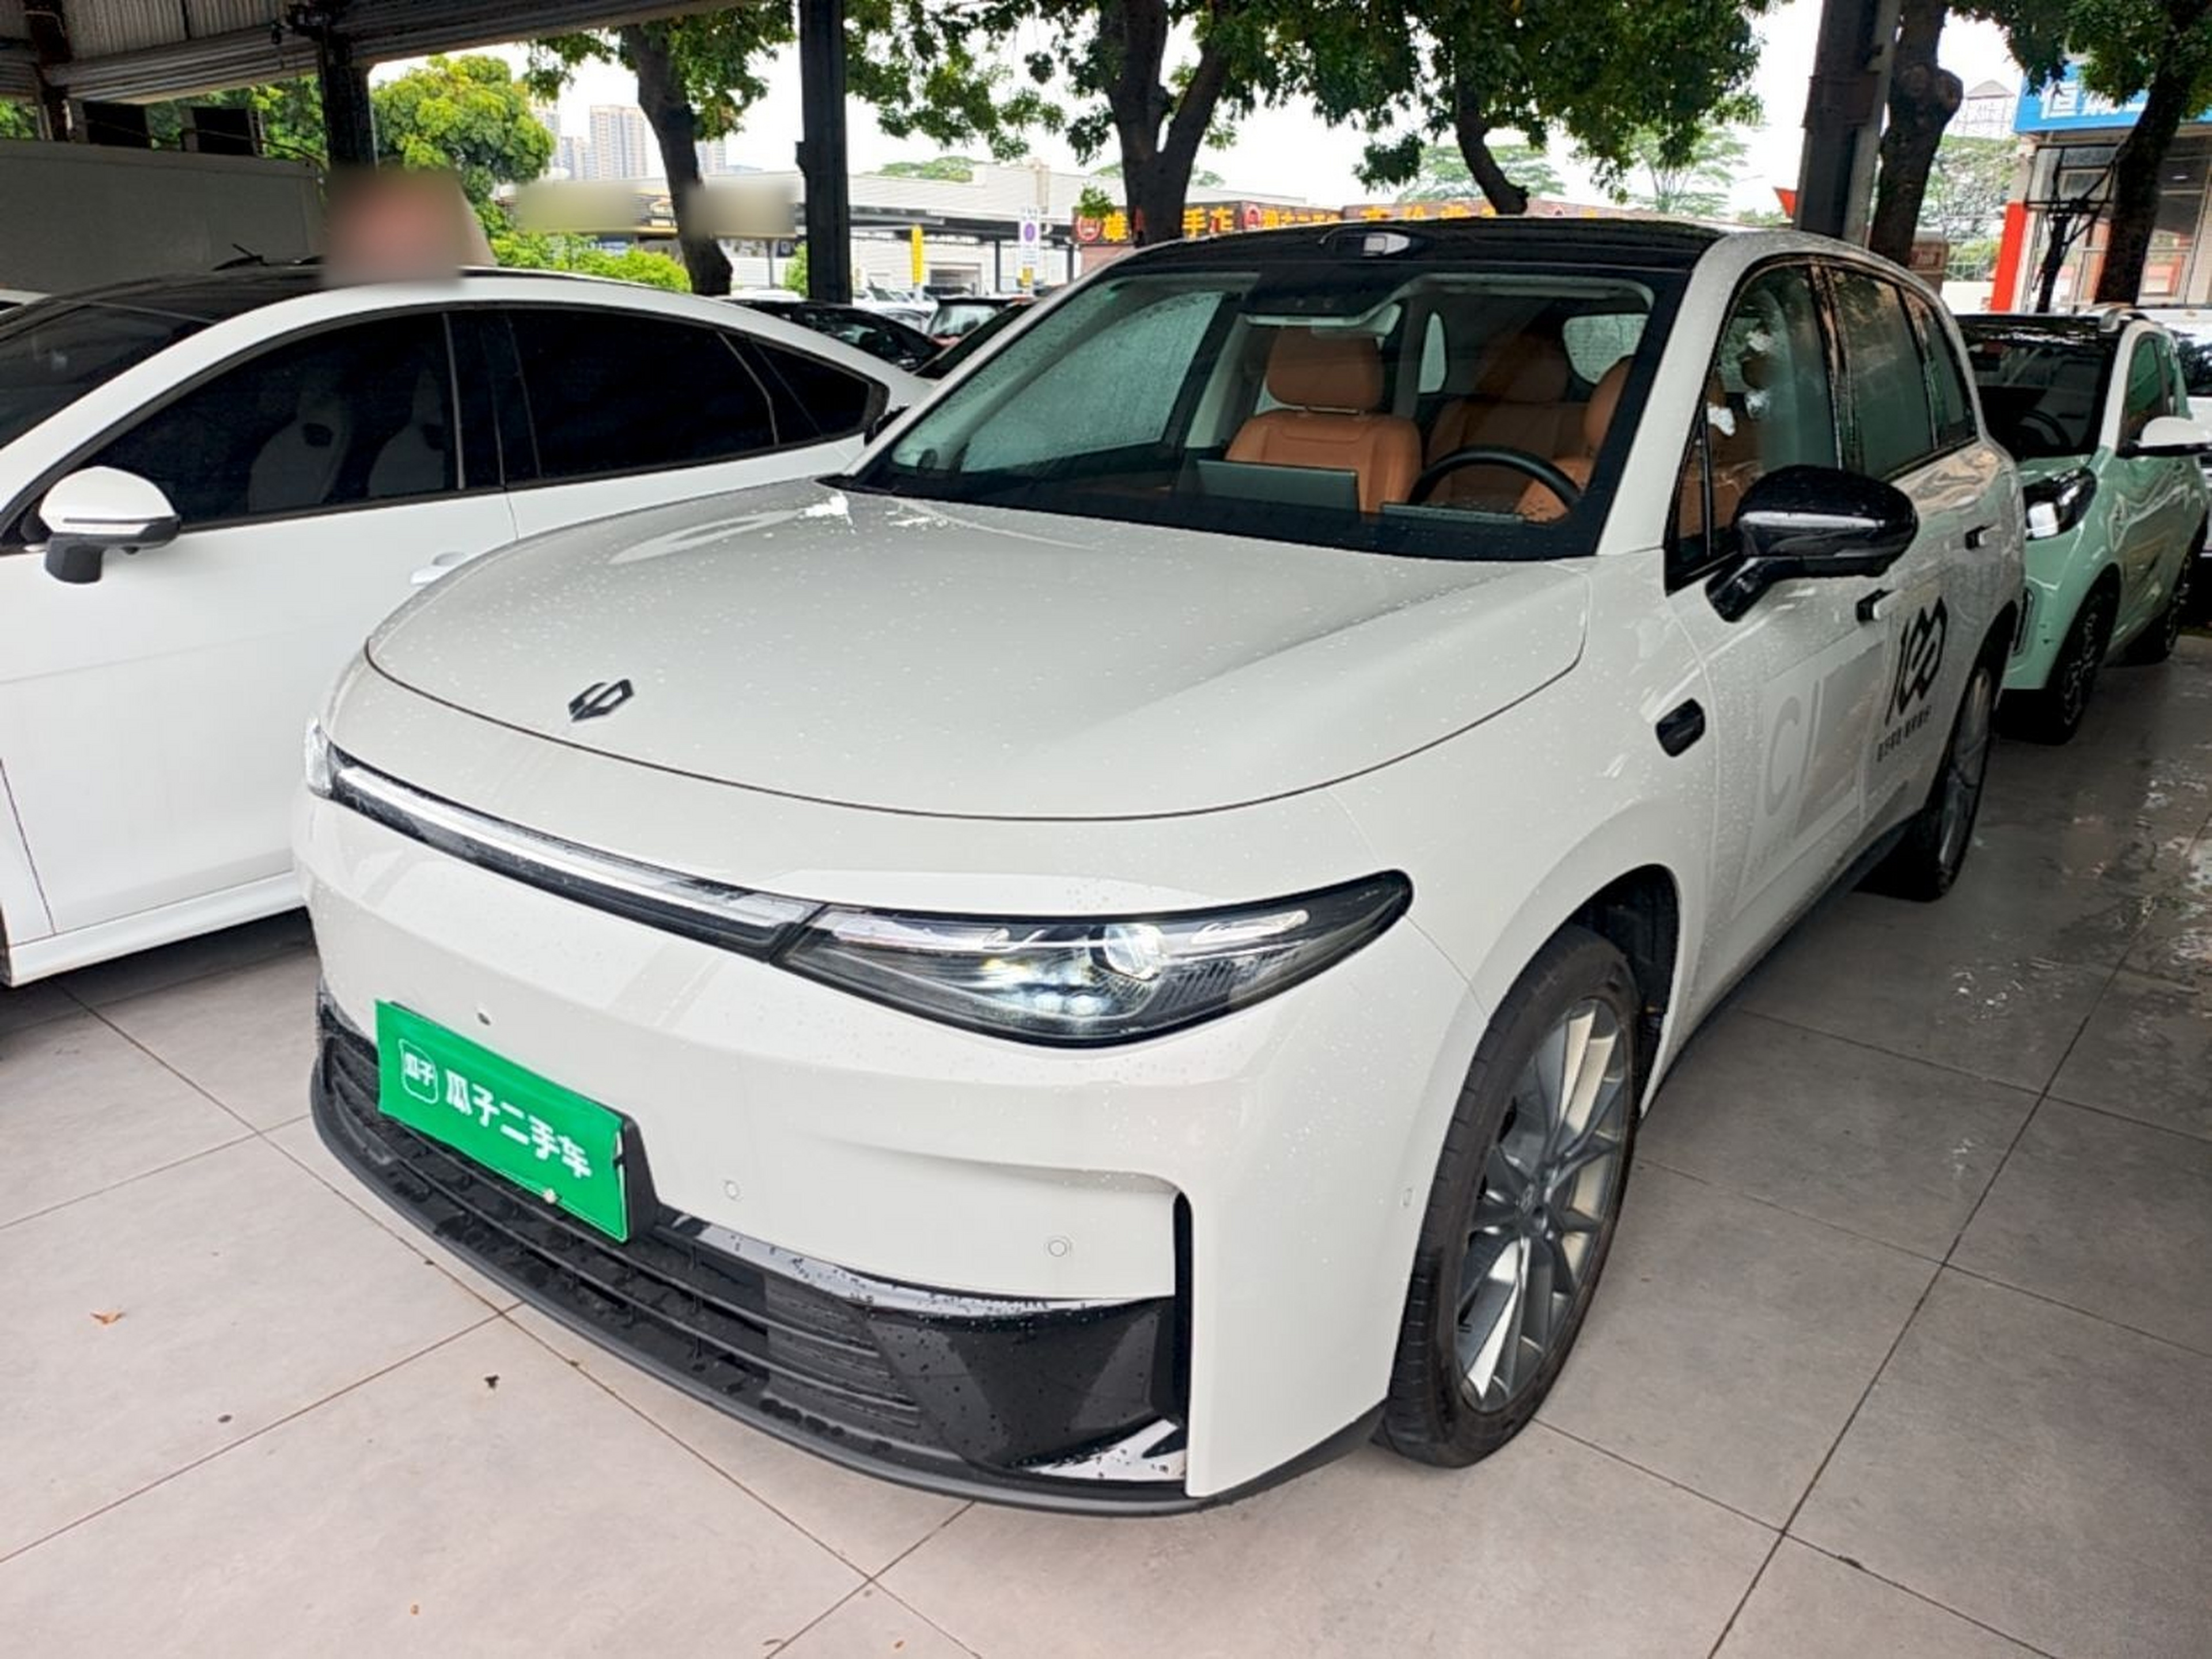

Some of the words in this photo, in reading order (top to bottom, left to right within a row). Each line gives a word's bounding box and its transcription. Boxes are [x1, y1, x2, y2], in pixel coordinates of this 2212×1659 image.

[446, 1069, 592, 1179] 瓜子二手车
